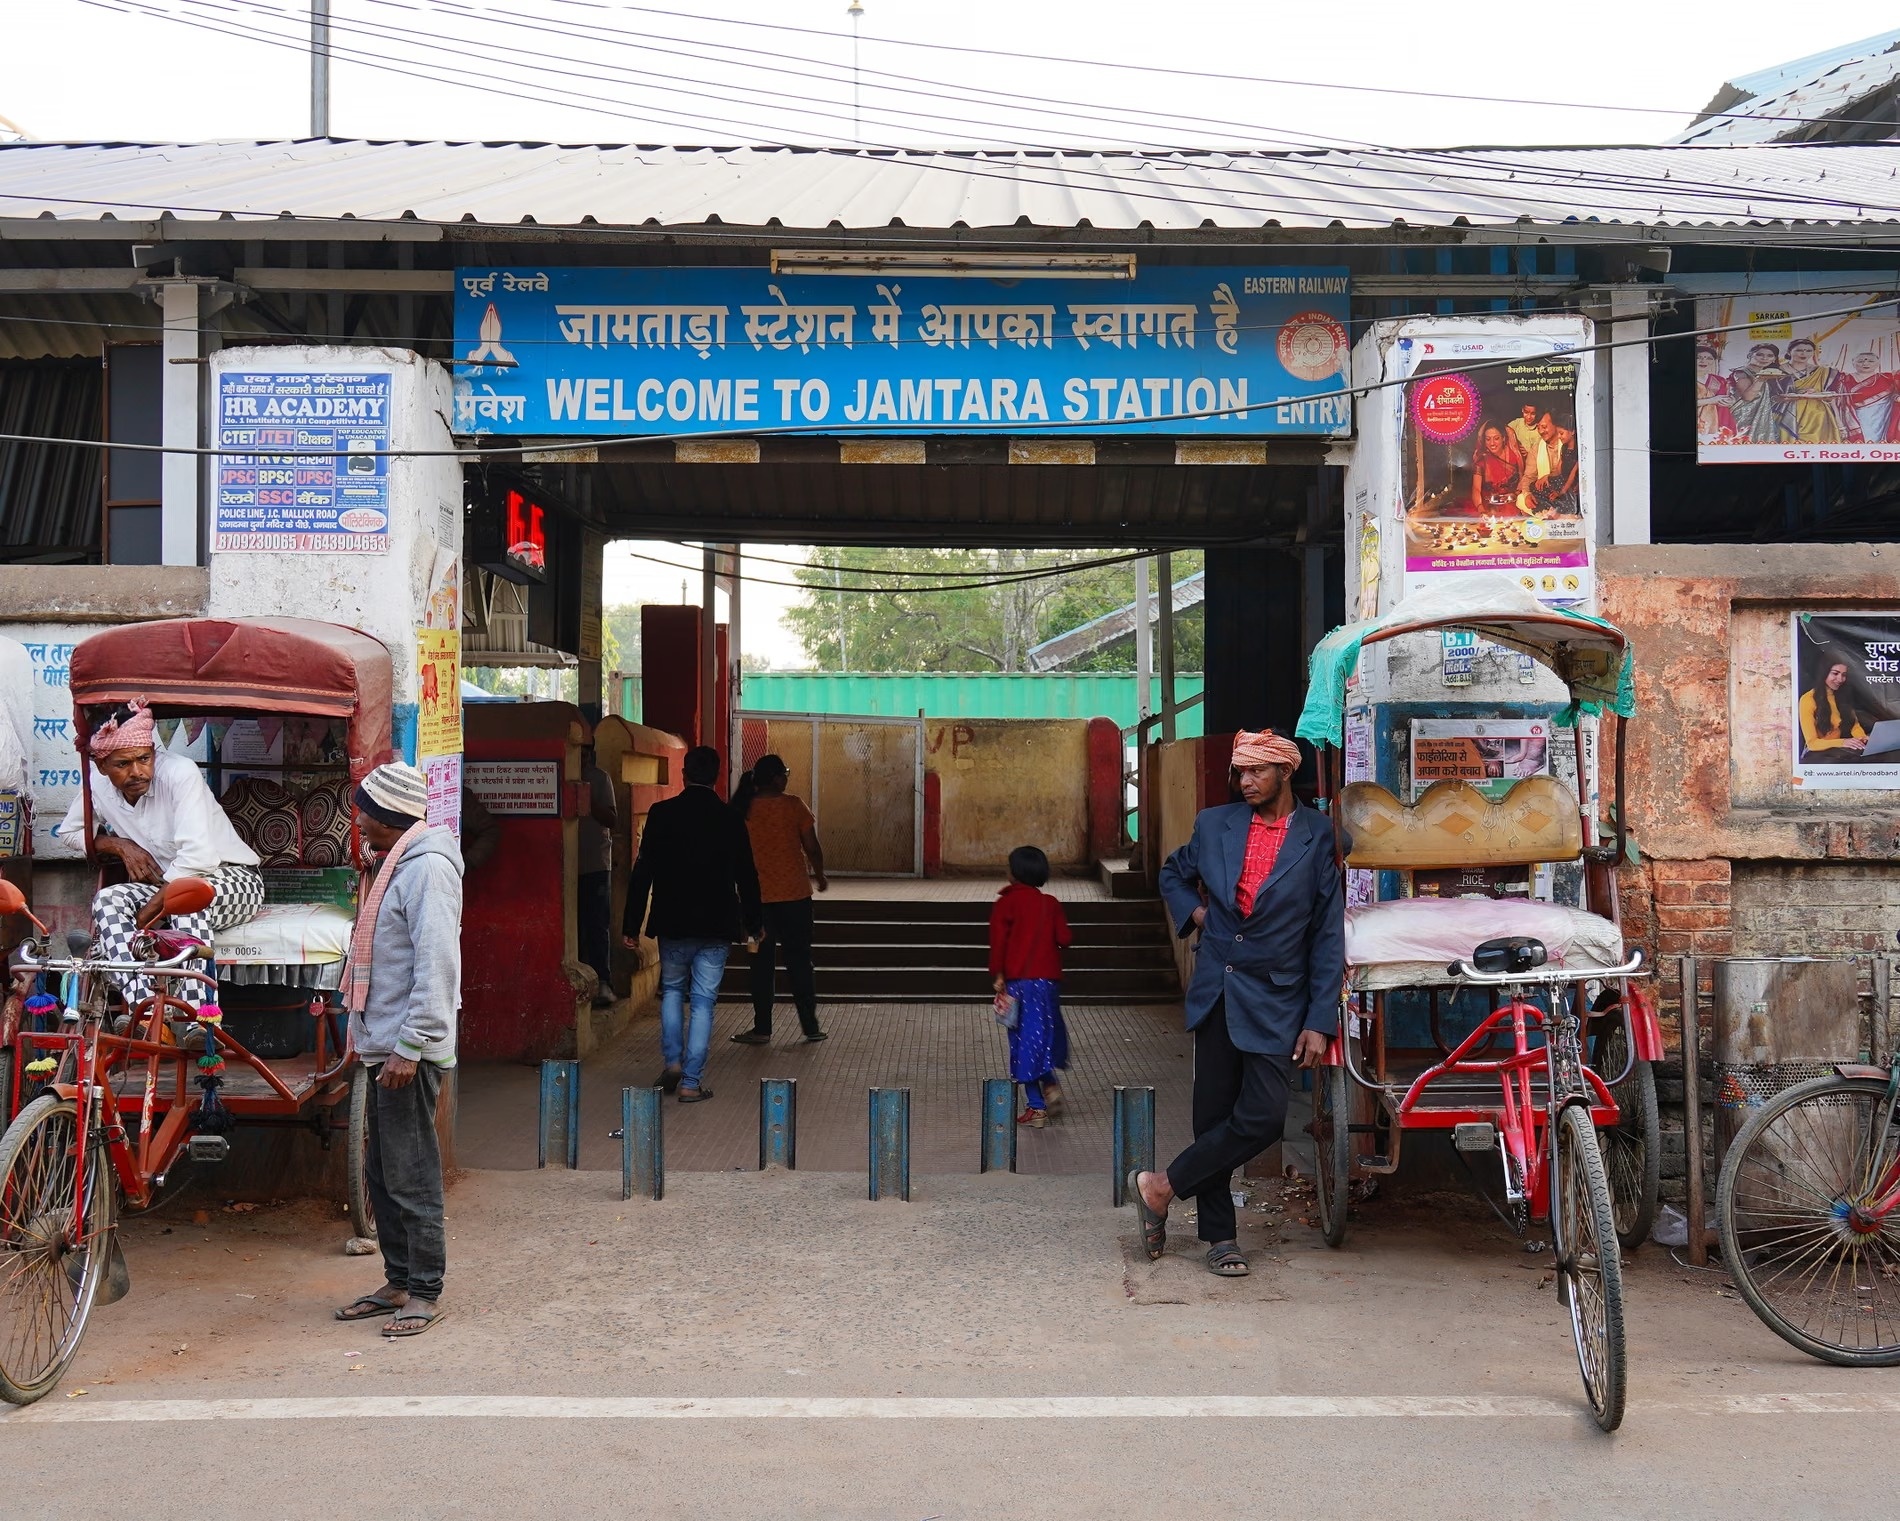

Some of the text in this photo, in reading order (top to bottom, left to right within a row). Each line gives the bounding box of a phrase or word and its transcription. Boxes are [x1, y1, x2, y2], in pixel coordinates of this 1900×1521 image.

[463, 272, 549, 297] पूर्व रेलवे
[1244, 277, 1348, 294] EASTERN RAILWAY
[555, 283, 1240, 360] जामताड़ा स्टेशन में आपका स्वागत है
[243, 374, 272, 383] एक
[312, 374, 368, 383] संस्थान
[250, 385, 266, 394] समय
[275, 384, 312, 395] सरकारी
[314, 384, 344, 395] नौकरी
[454, 384, 527, 424] प्रवेश
[546, 377, 1248, 422] WELCOME TO JAMTARA STATION
[224, 398, 385, 417] HR ACADEMY
[1277, 396, 1349, 424] ENTRY
[308, 417, 357, 426] Competitive
[358, 417, 383, 425] Exam.
[222, 430, 256, 445] CTET
[257, 430, 294, 445] JTET
[298, 430, 332, 446] शिक्षक
[1784, 450, 1814, 460] G.T.
[1819, 450, 1865, 461] Road,
[222, 469, 256, 484] JPSC
[260, 469, 294, 484] BPSC
[297, 469, 332, 484] UPSC
[220, 490, 255, 505] रेलवे
[260, 489, 294, 504] SSC
[297, 491, 331, 505] बैंक
[220, 509, 338, 521] POLICE LINE, J.C. MALLICK ROAD
[1864, 656, 1899, 671] स्पीड
[1865, 673, 1894, 684] एयरटेल
[1459, 749, 1467, 762] से
[496, 765, 511, 774] टिकट
[1416, 766, 1441, 776] अपना
[1460, 766, 1481, 776] बचाव
[1816, 769, 1898, 777] www.airtel.in/broadband
[483, 792, 497, 800] ENTER
[498, 792, 521, 800] PLATFORM
[521, 792, 535, 800] AREA
[534, 792, 556, 800] WITHOUT
[490, 801, 505, 809] TICKET
[506, 801, 513, 809] OR
[513, 801, 537, 809] PLATFORM
[1462, 874, 1484, 886] RICE
